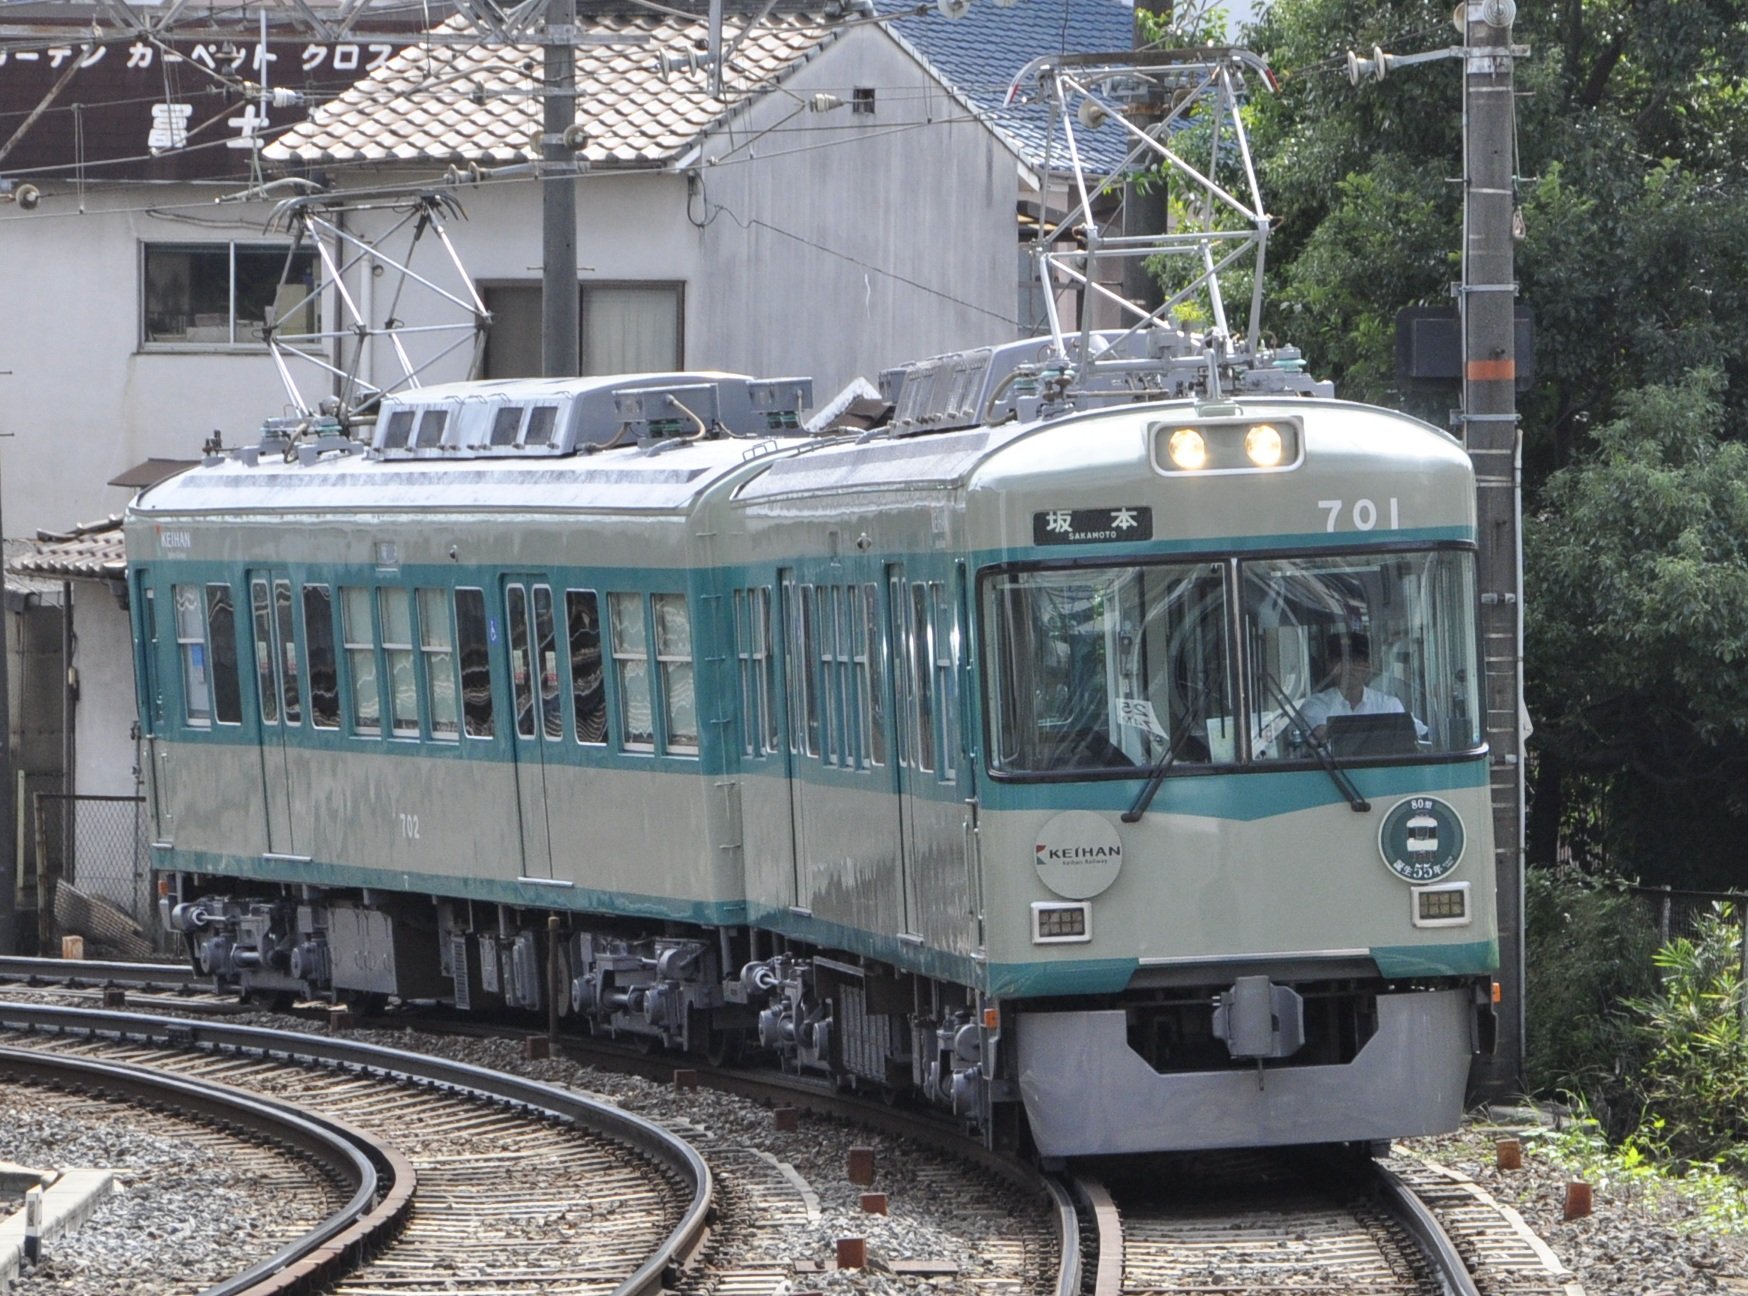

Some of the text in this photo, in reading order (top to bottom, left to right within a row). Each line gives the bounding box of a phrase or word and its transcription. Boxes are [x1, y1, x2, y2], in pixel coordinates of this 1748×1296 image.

[302, 43, 392, 71] クロス
[1046, 508, 1138, 533] 坂本
[1318, 497, 1399, 533] 701
[160, 531, 192, 548] KEIHAN
[1068, 531, 1117, 540] SAKAMOTO
[400, 813, 420, 839] 702
[1049, 846, 1120, 859] KEIHAN
